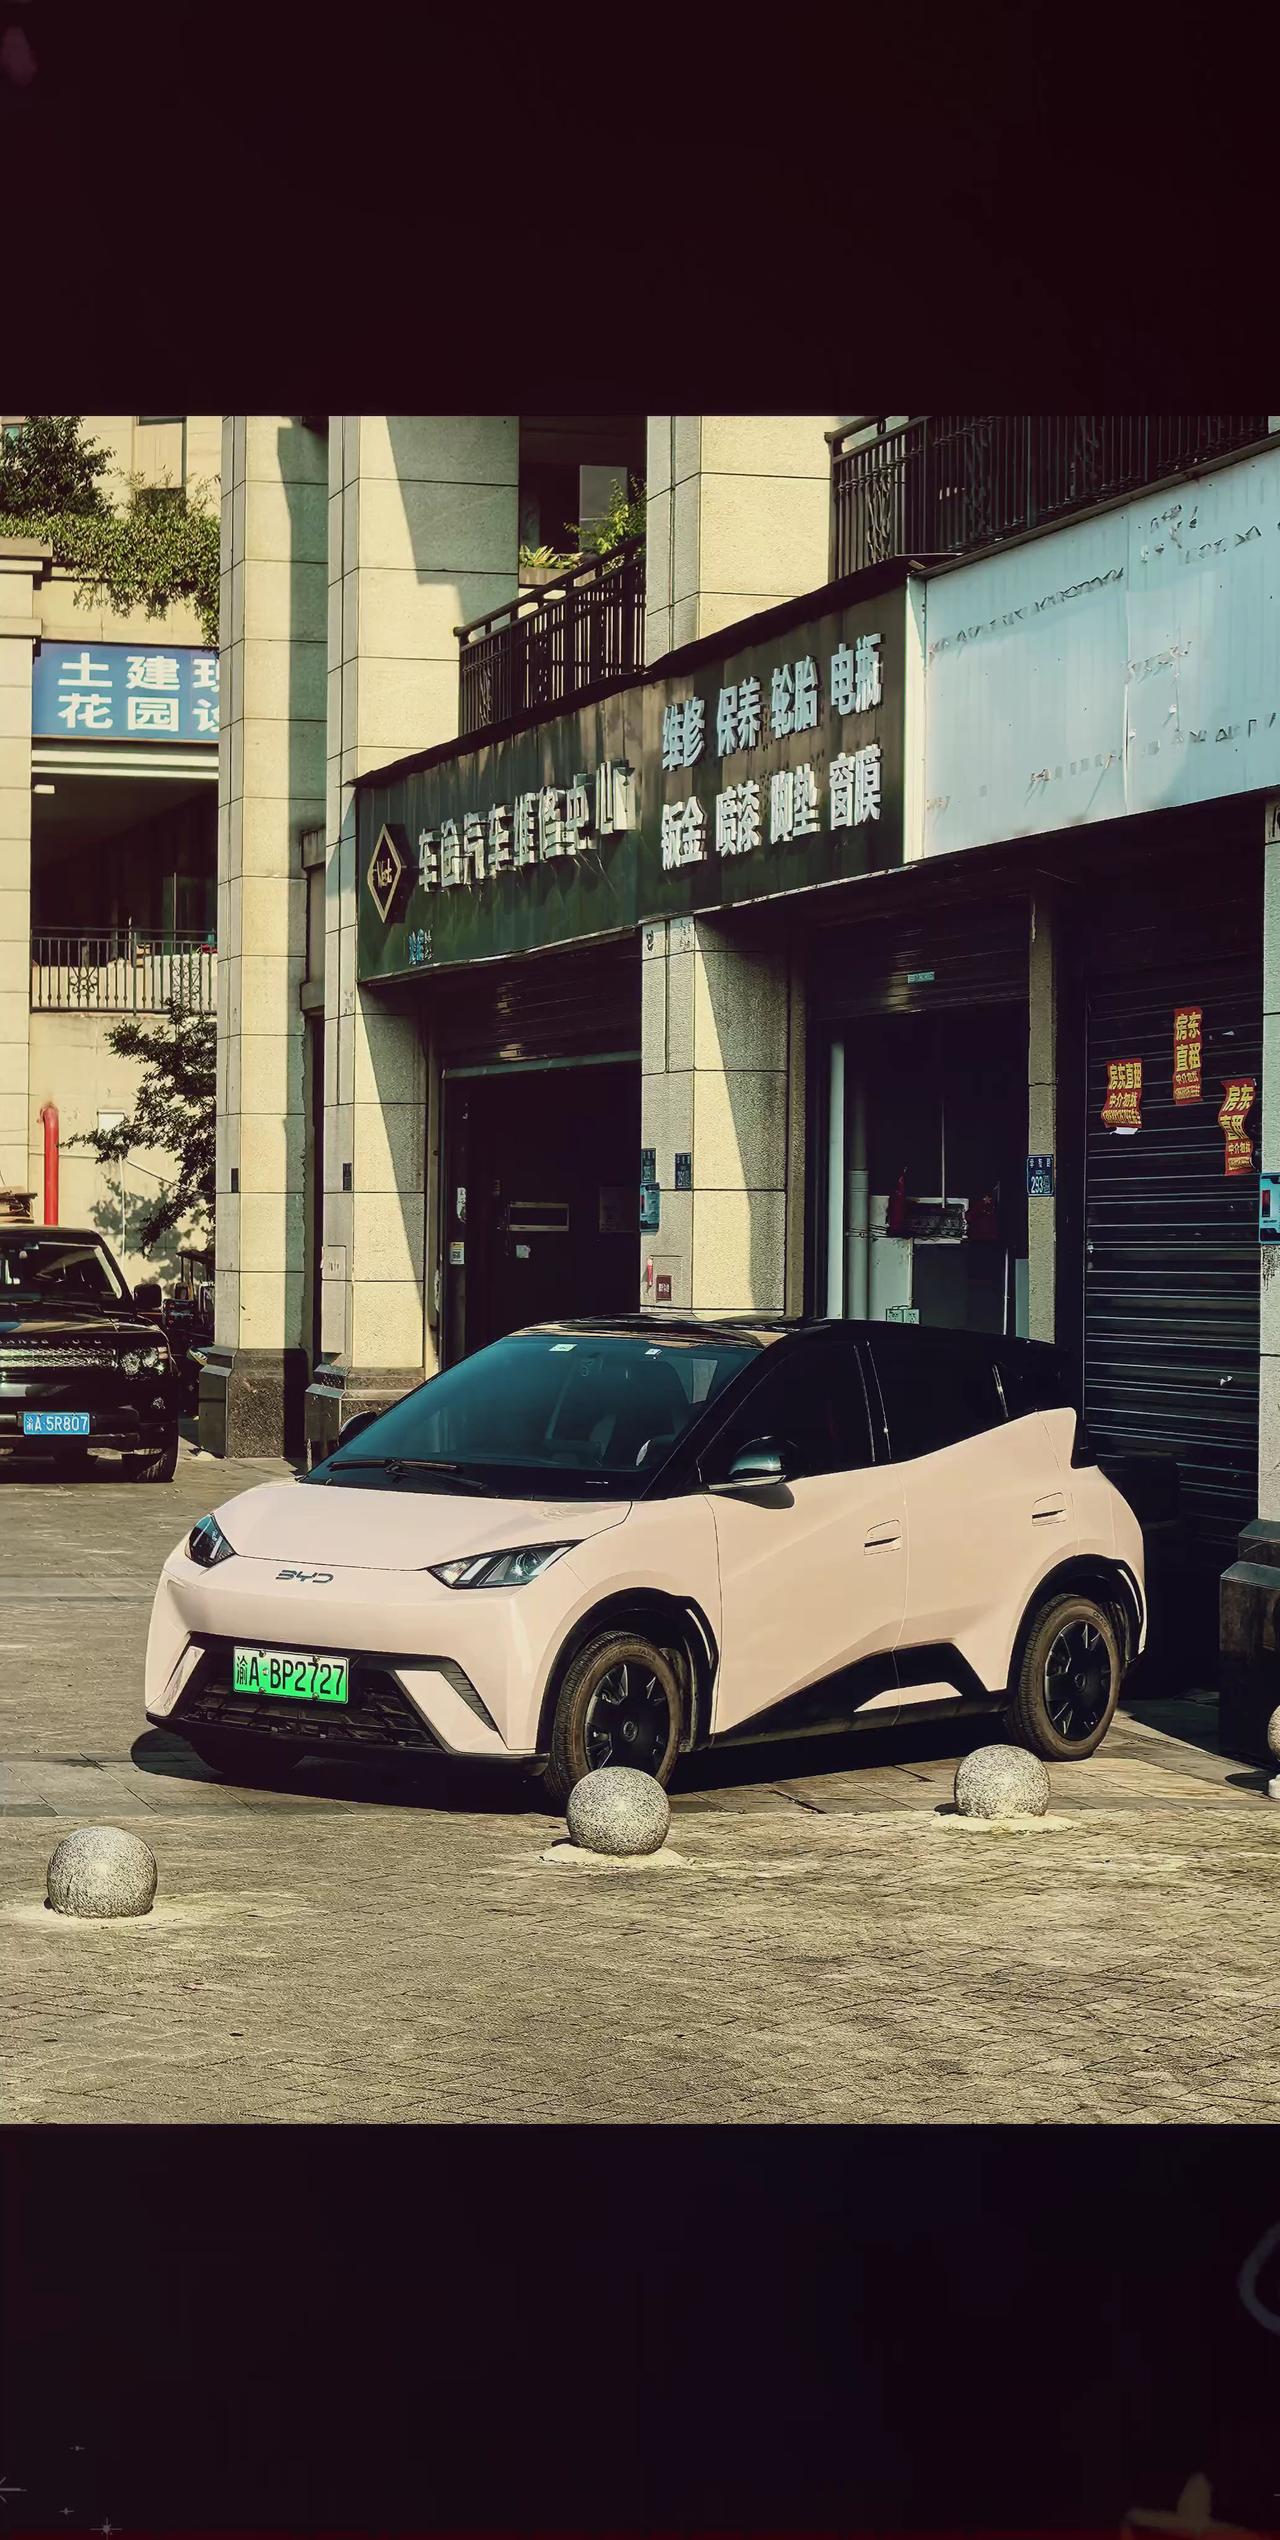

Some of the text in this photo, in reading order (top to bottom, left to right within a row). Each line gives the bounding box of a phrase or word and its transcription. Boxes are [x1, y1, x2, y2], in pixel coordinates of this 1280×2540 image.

[661, 633, 884, 772] 维修 保养 轮胎 电瓶
[715, 780, 762, 858] 喷漆
[770, 763, 821, 845] 脚垫
[829, 743, 882, 831] 窗膜
[1175, 1011, 1202, 1041] 房东
[1175, 1042, 1201, 1072] 直租
[1222, 1083, 1254, 1112] 房东
[275, 1569, 334, 1584] BYD
